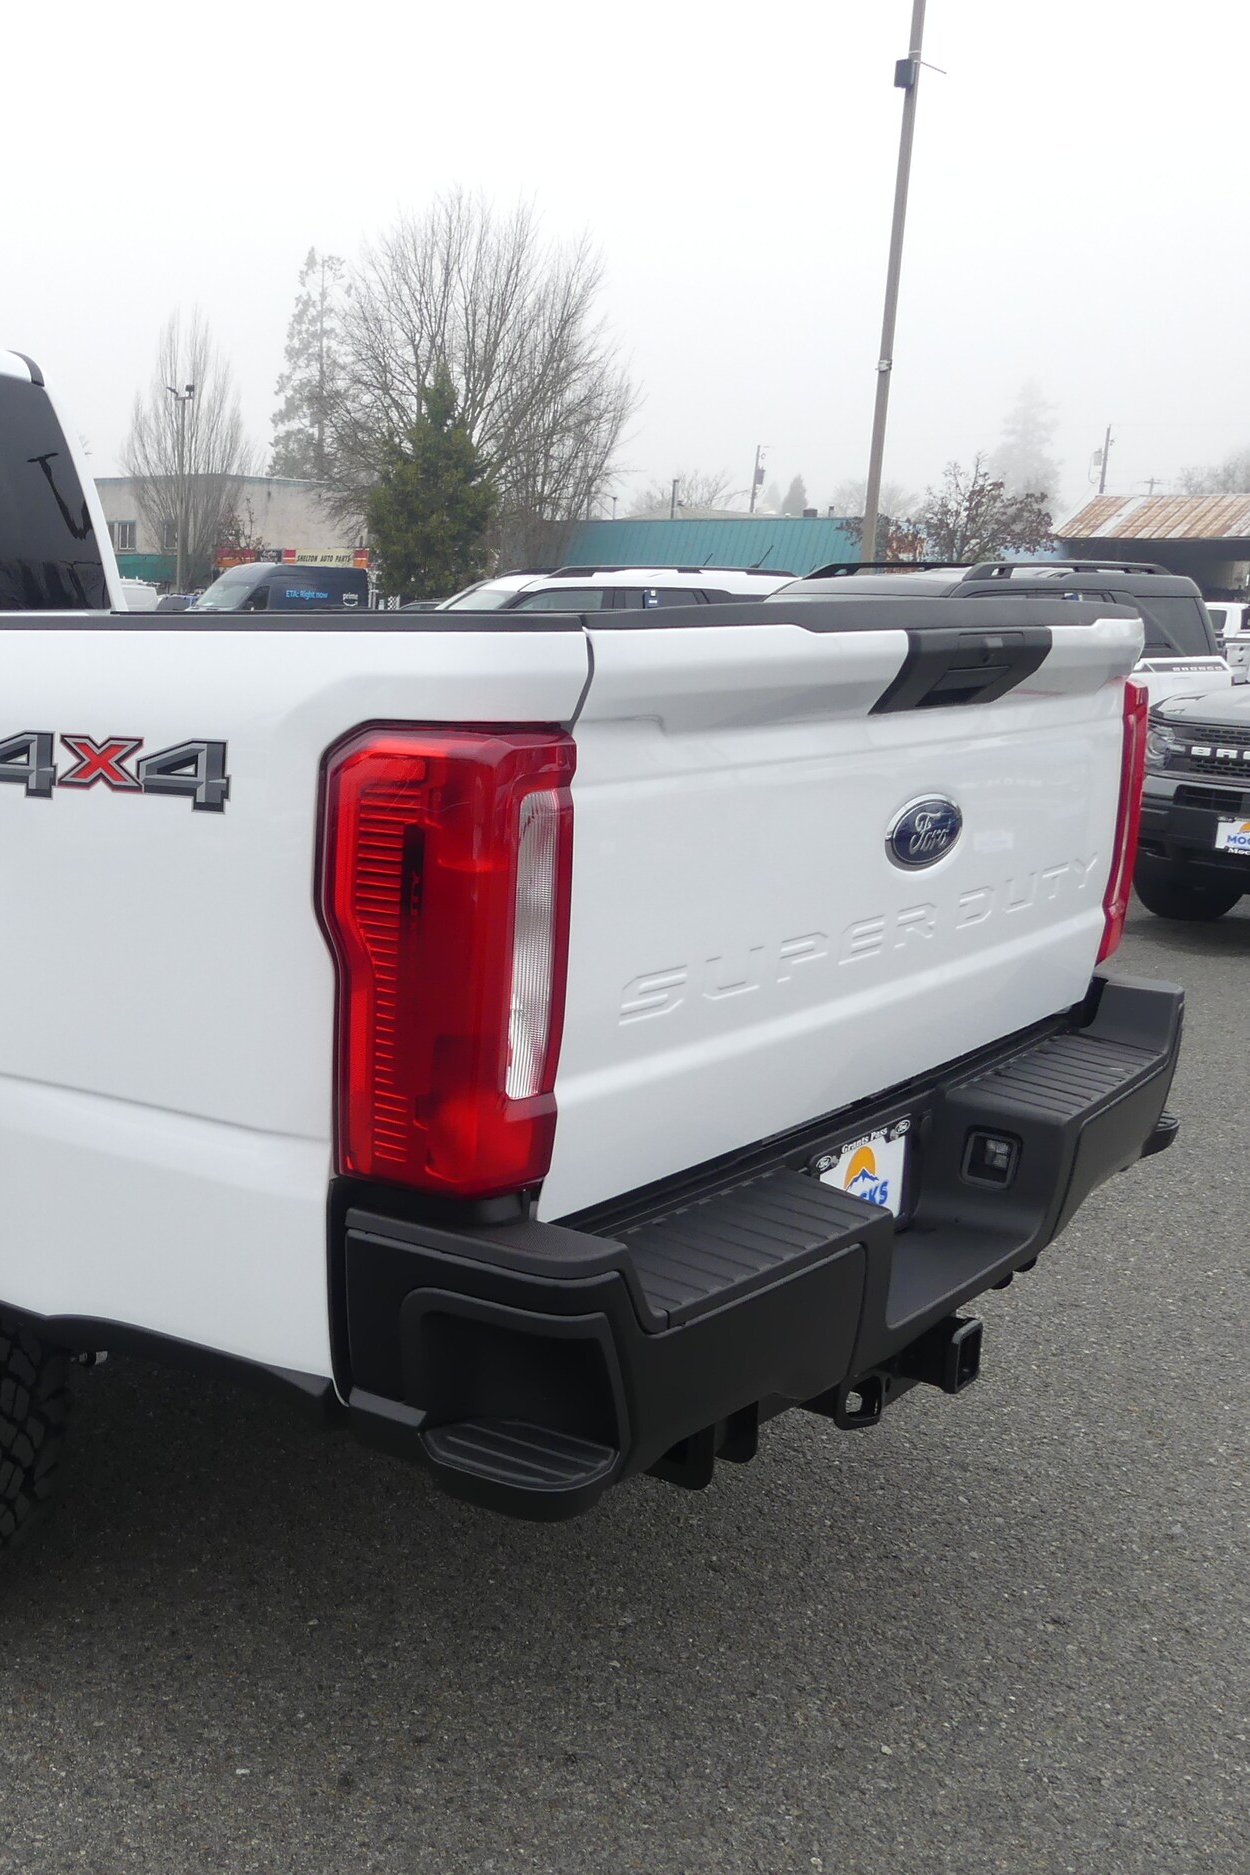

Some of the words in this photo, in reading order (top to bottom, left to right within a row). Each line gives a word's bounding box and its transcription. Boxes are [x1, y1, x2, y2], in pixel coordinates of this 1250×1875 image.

[296, 553, 319, 563] SHELTON
[320, 553, 334, 563] AUTO
[335, 553, 352, 563] PARTS
[285, 589, 299, 598] ETA:
[300, 590, 315, 600] Right
[342, 592, 359, 601] prime
[908, 811, 952, 855] Ford
[618, 902, 938, 1027] SUPER
[954, 852, 1099, 930] DUTY
[841, 1136, 870, 1154] Grants
[869, 1127, 888, 1141] Pass
